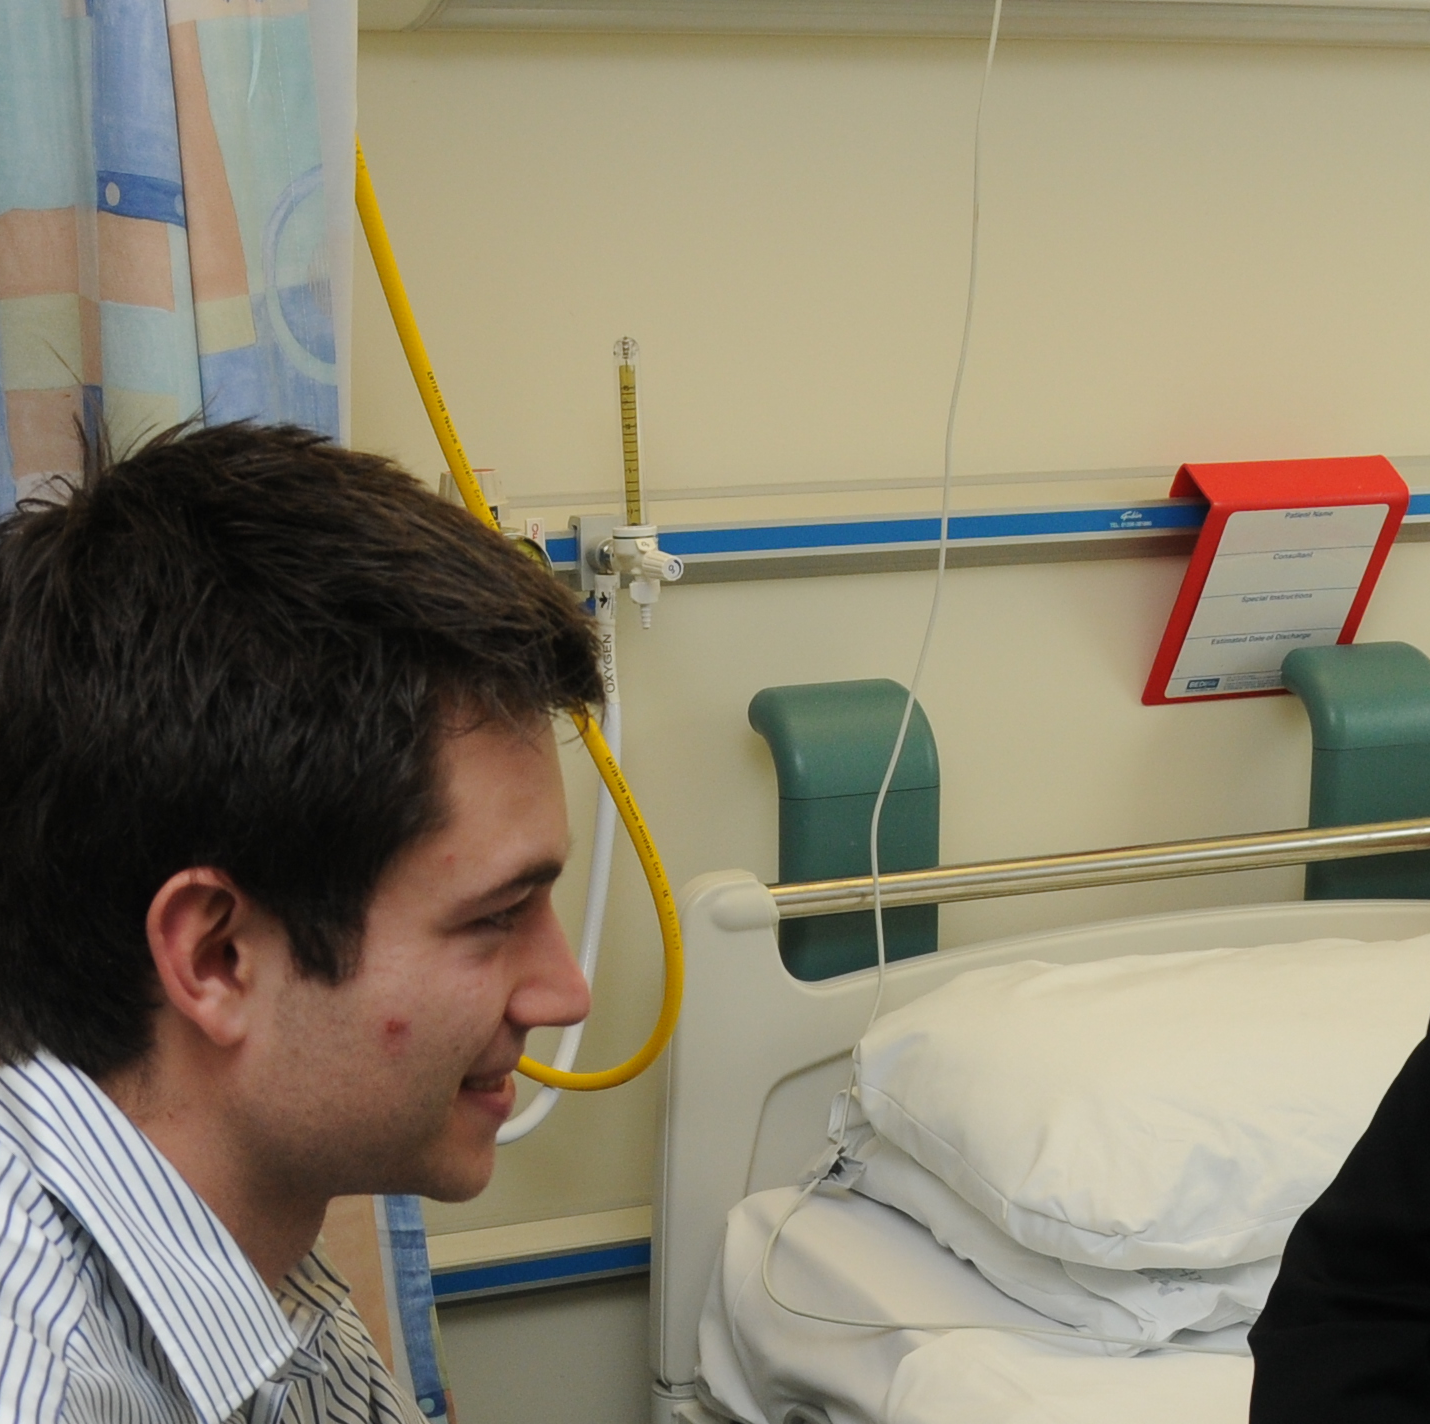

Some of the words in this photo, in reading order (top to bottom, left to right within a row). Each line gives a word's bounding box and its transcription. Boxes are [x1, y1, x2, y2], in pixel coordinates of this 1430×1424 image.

[1284, 511, 1310, 520] Patient
[1312, 510, 1334, 518] Name
[1272, 552, 1314, 560] Consultant
[1241, 594, 1268, 603] Special
[1269, 592, 1313, 601] Instructions
[1210, 636, 1247, 645] Estimated
[1248, 635, 1267, 643] Date
[1266, 634, 1275, 642] of
[1275, 632, 1312, 641] Discharge
[603, 633, 616, 693] OXYGEN
